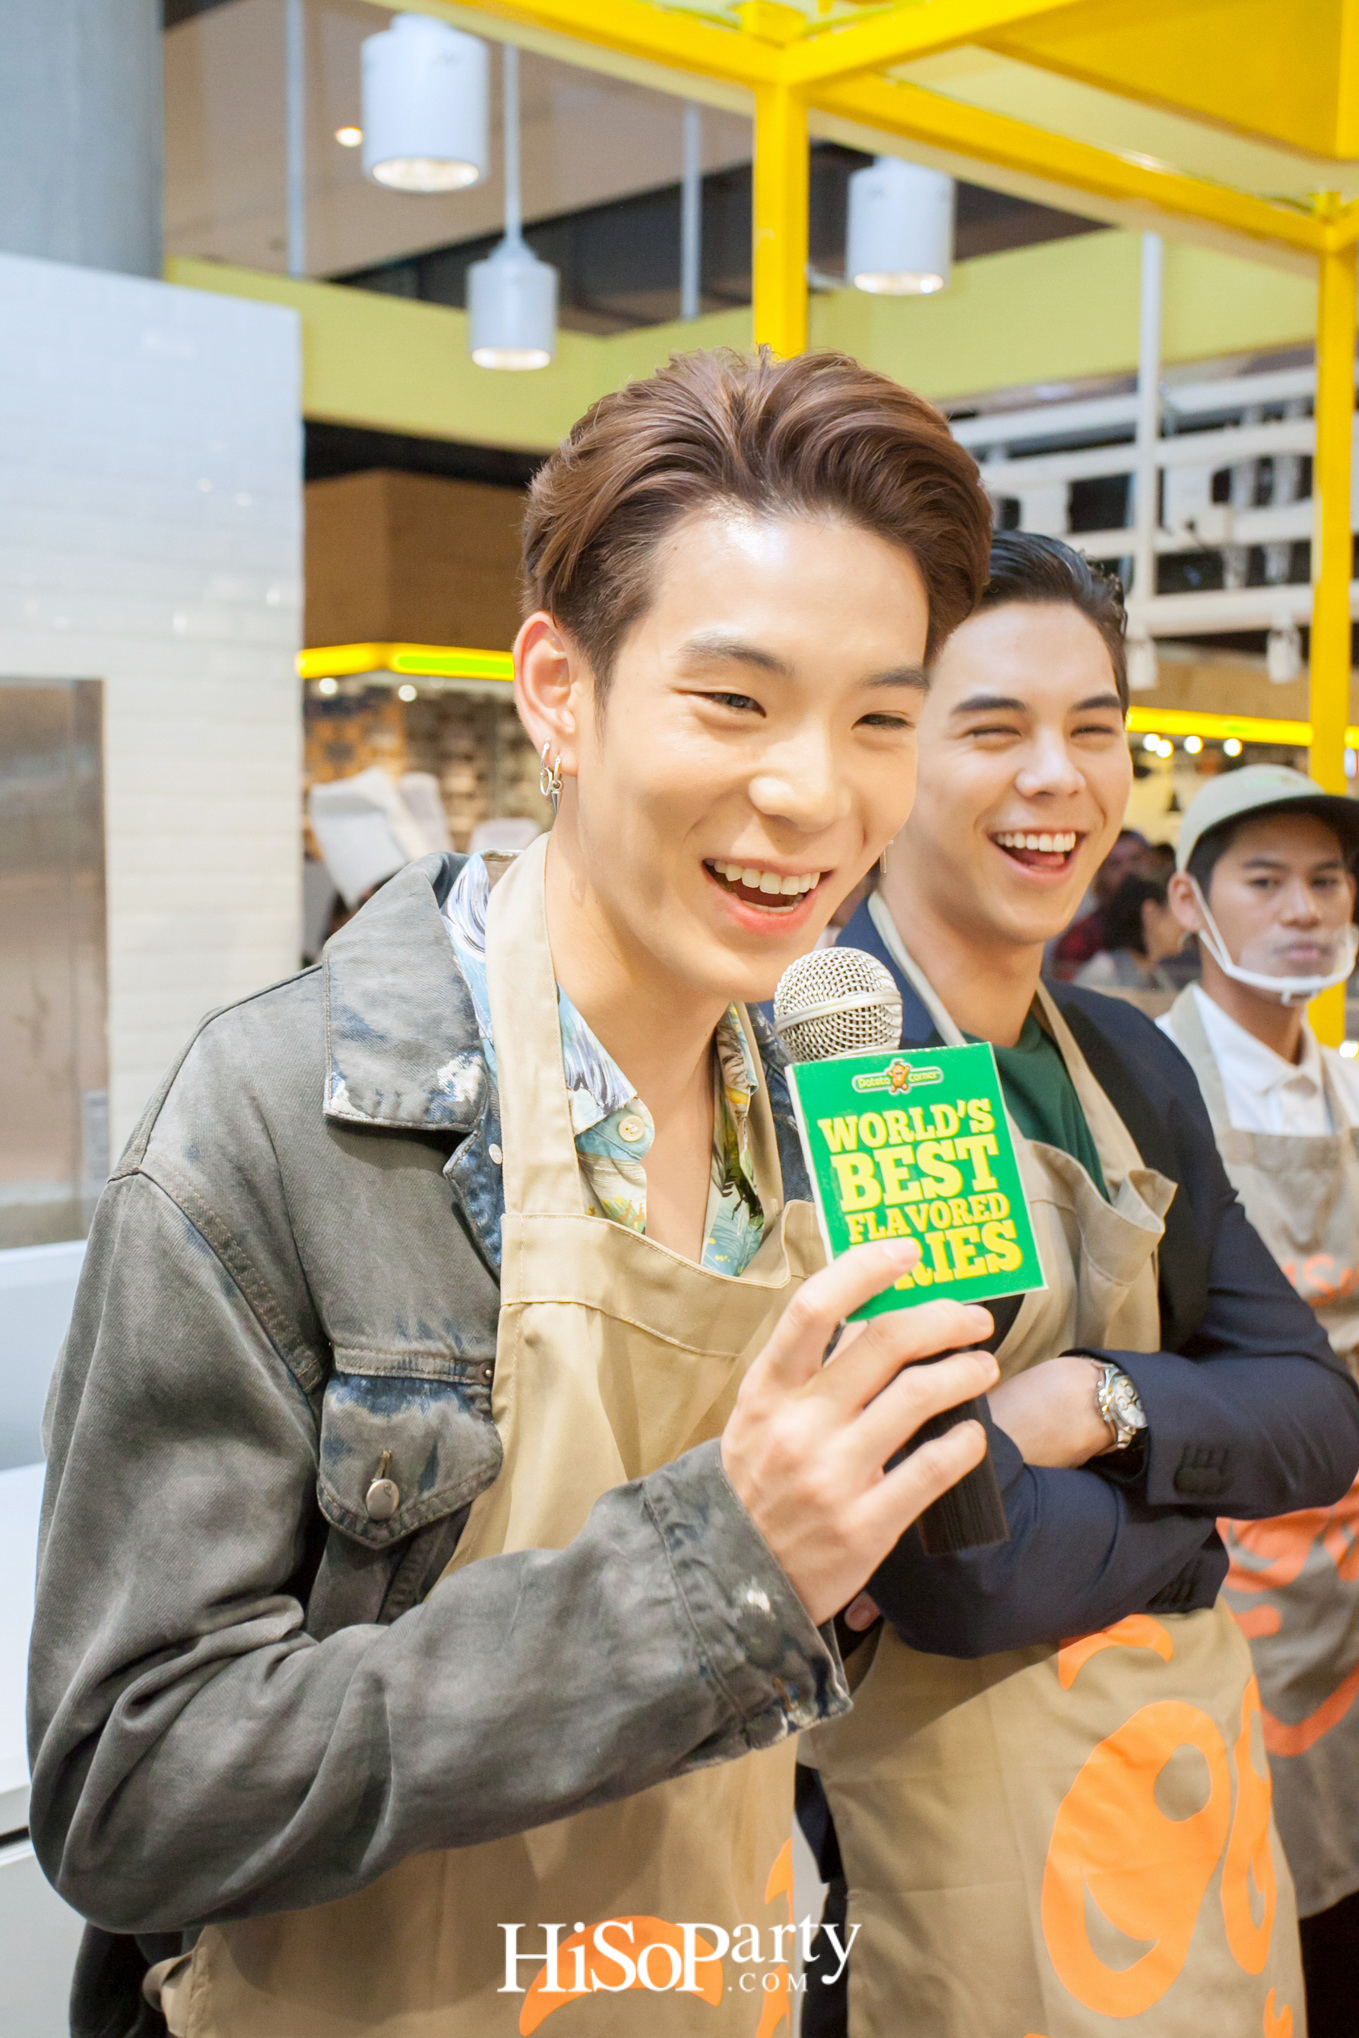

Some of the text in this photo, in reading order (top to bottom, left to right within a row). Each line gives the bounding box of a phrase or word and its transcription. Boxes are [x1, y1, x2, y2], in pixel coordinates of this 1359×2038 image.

[817, 1098, 996, 1153] WORLD'S
[830, 1134, 999, 1213] BEST
[845, 1192, 1010, 1243] FLAVORED
[852, 1219, 1023, 1291] IES
